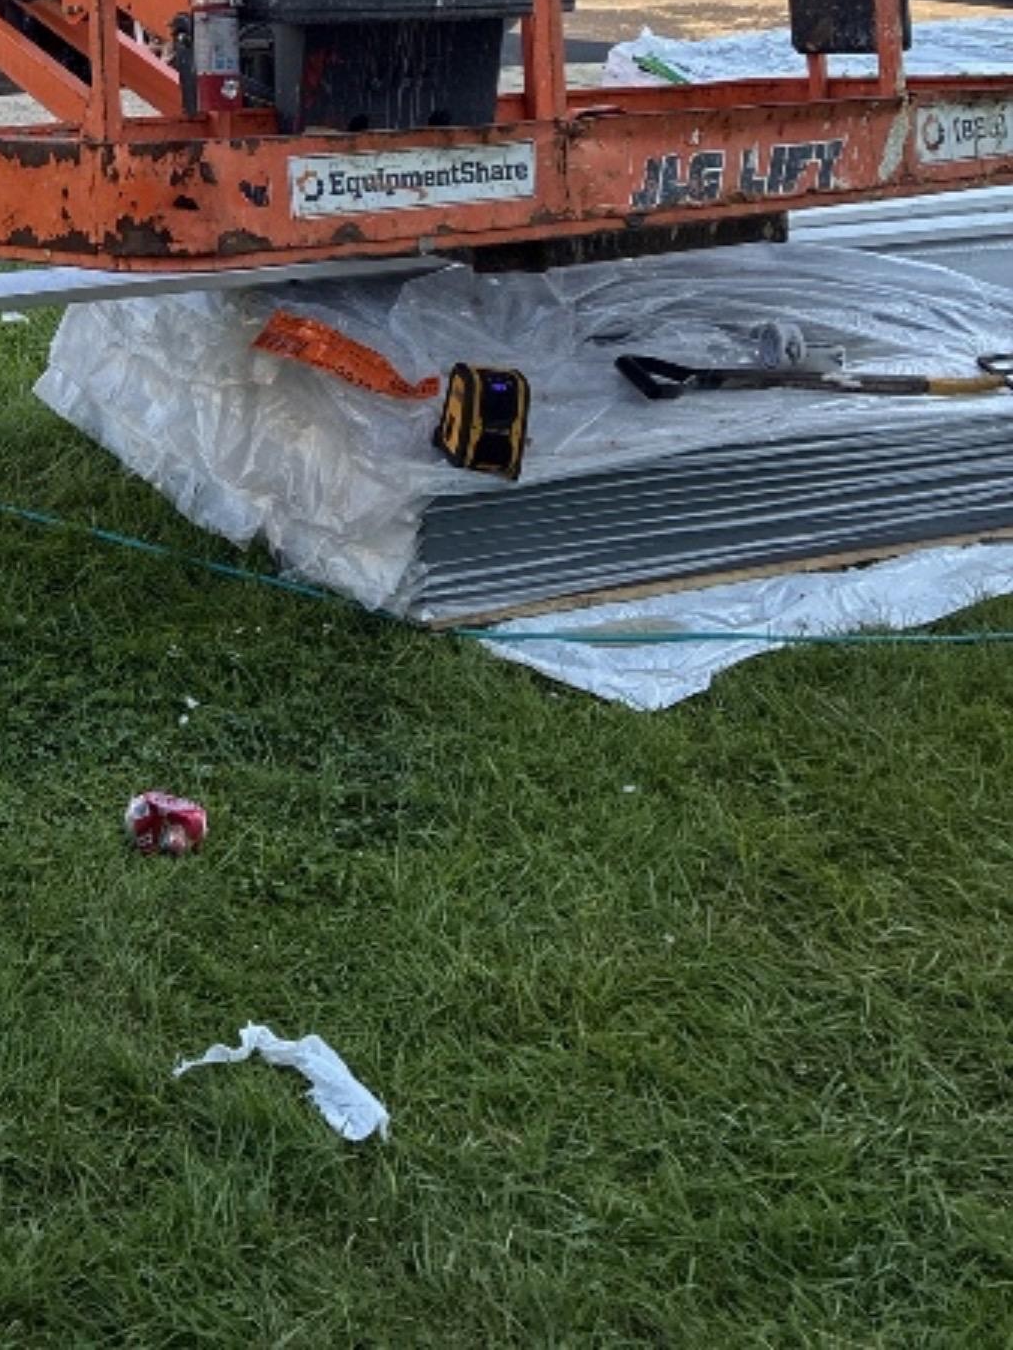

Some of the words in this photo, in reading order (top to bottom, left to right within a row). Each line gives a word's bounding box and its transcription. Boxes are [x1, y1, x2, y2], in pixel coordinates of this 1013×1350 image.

[328, 160, 529, 201] EquipmentShare
[629, 148, 726, 210] JLG
[740, 134, 849, 197] LIFT
